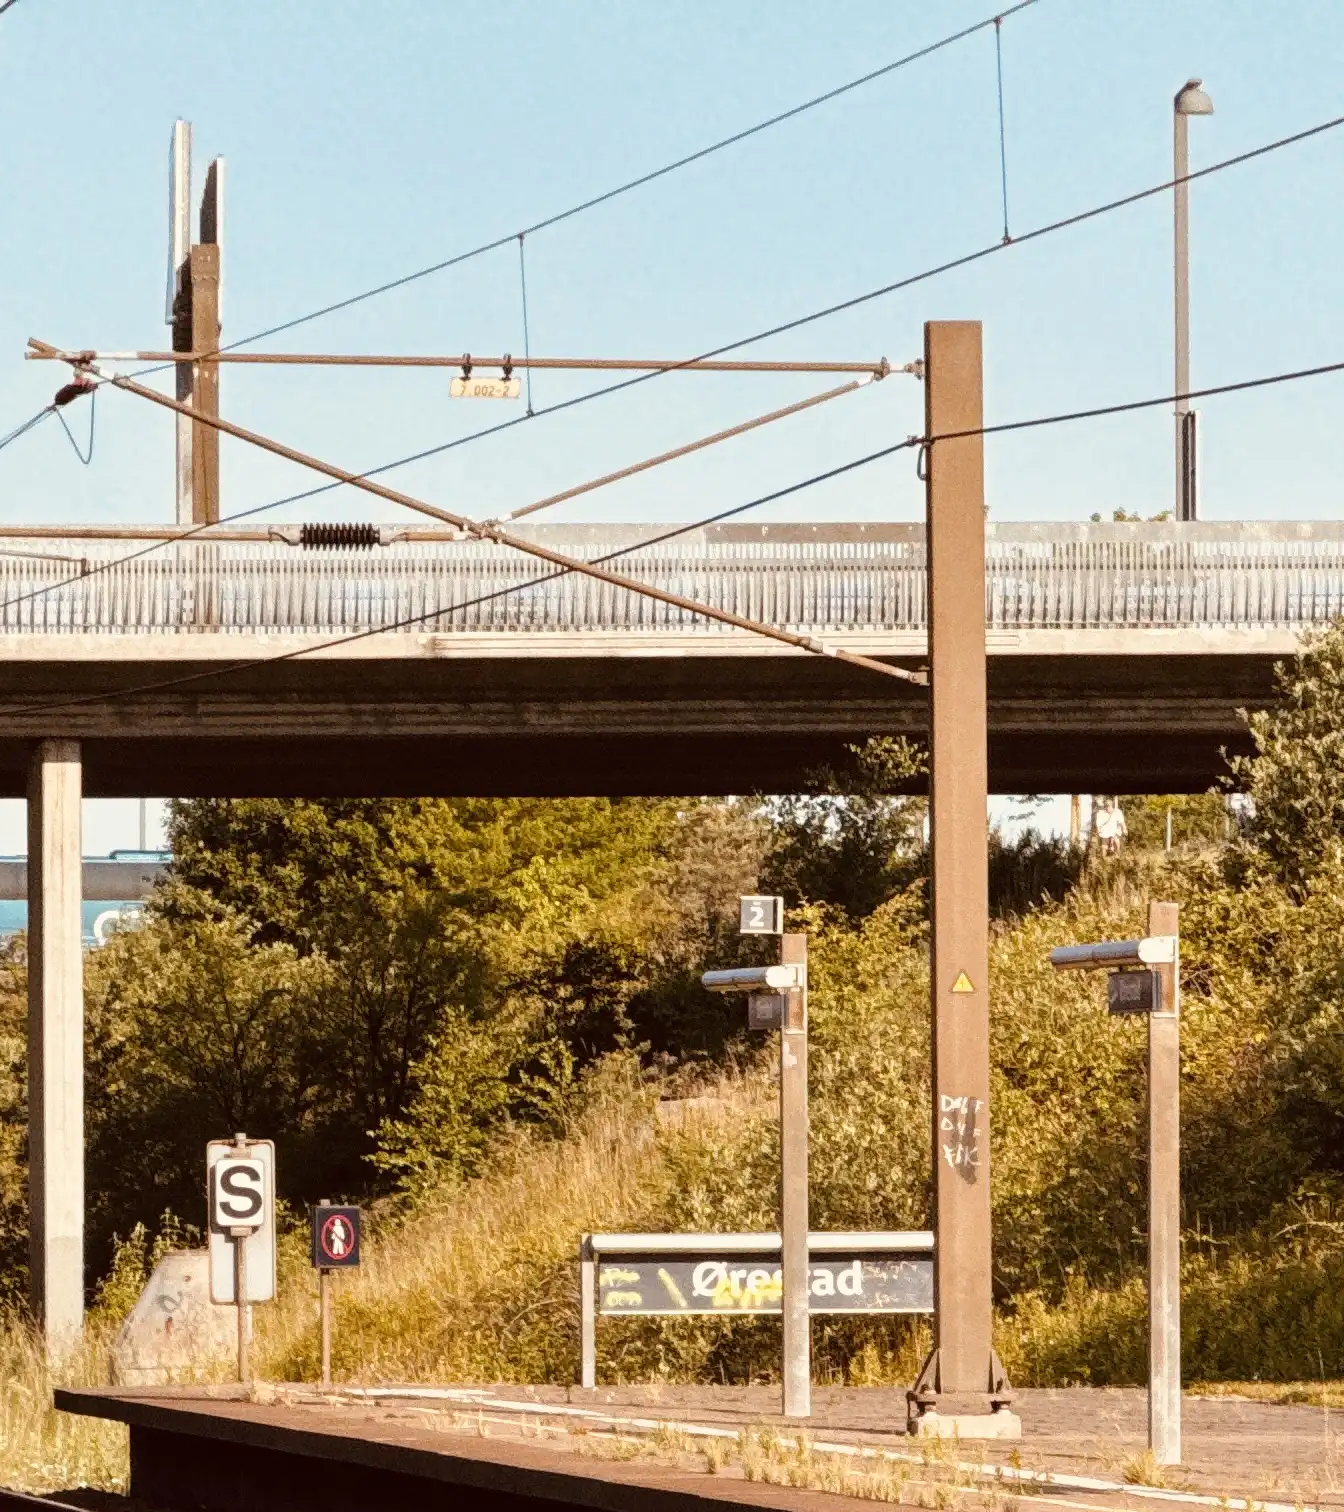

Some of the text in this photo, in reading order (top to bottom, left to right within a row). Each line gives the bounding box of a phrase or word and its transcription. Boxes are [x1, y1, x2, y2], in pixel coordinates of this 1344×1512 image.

[749, 906, 765, 928] 2
[219, 1165, 263, 1219] S
[692, 1260, 864, 1298] Øread
